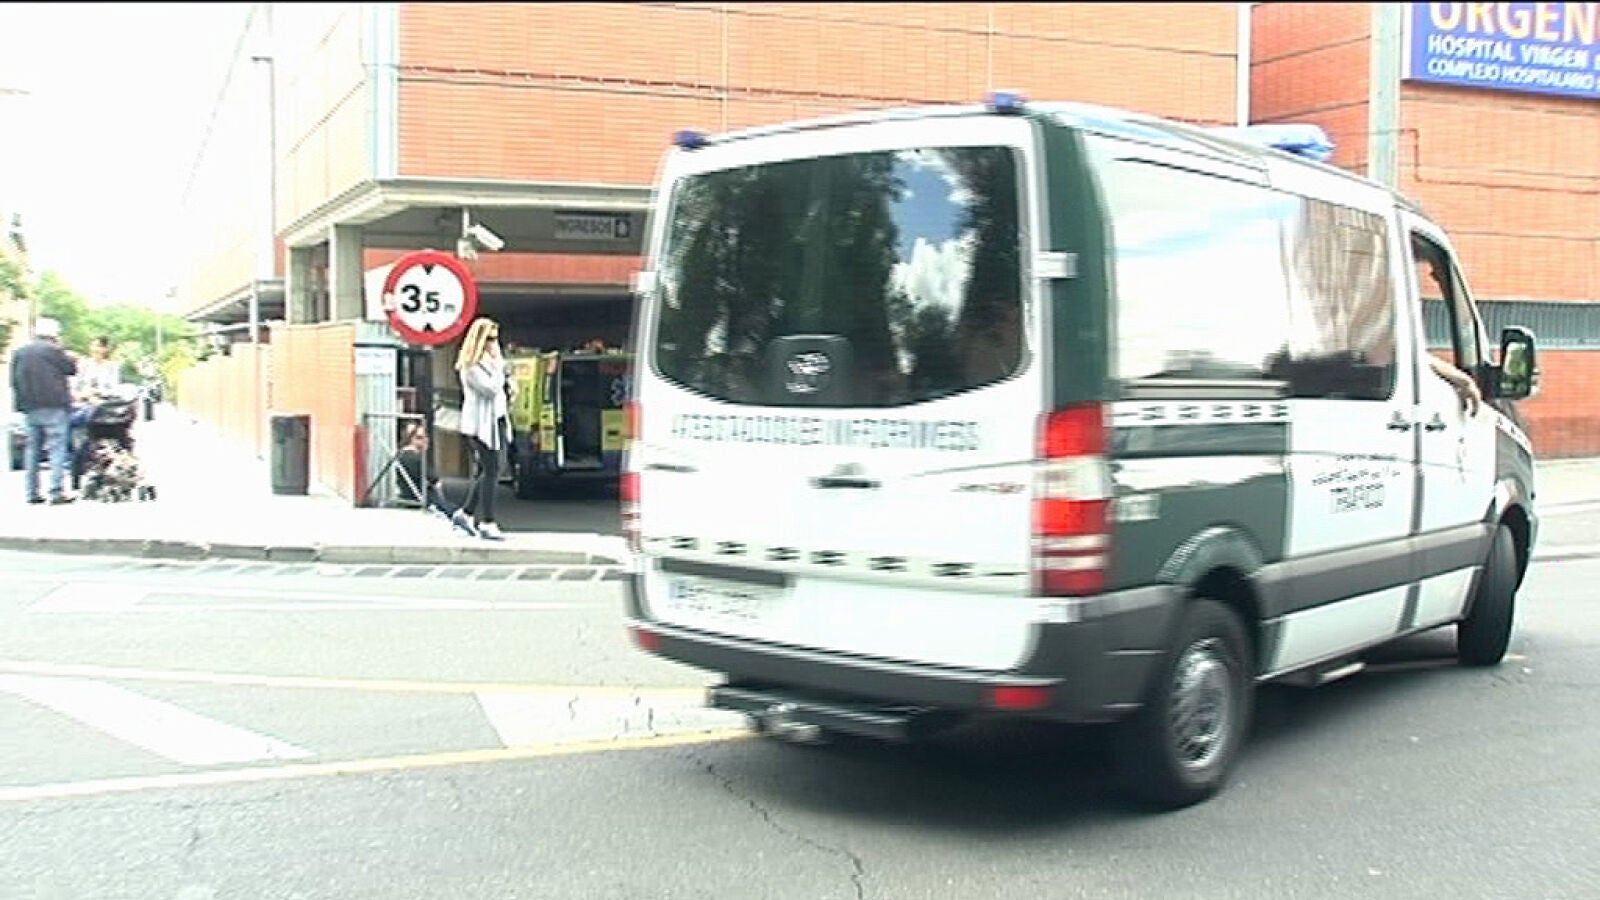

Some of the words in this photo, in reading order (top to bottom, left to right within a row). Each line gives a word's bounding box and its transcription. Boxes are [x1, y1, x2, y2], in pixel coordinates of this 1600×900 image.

[1427, 34, 1515, 62] HOSPITAL
[1520, 44, 1589, 68] VIRGEN
[1427, 57, 1499, 81] COMPLEJO
[1501, 66, 1595, 90] HOSPITALARIO
